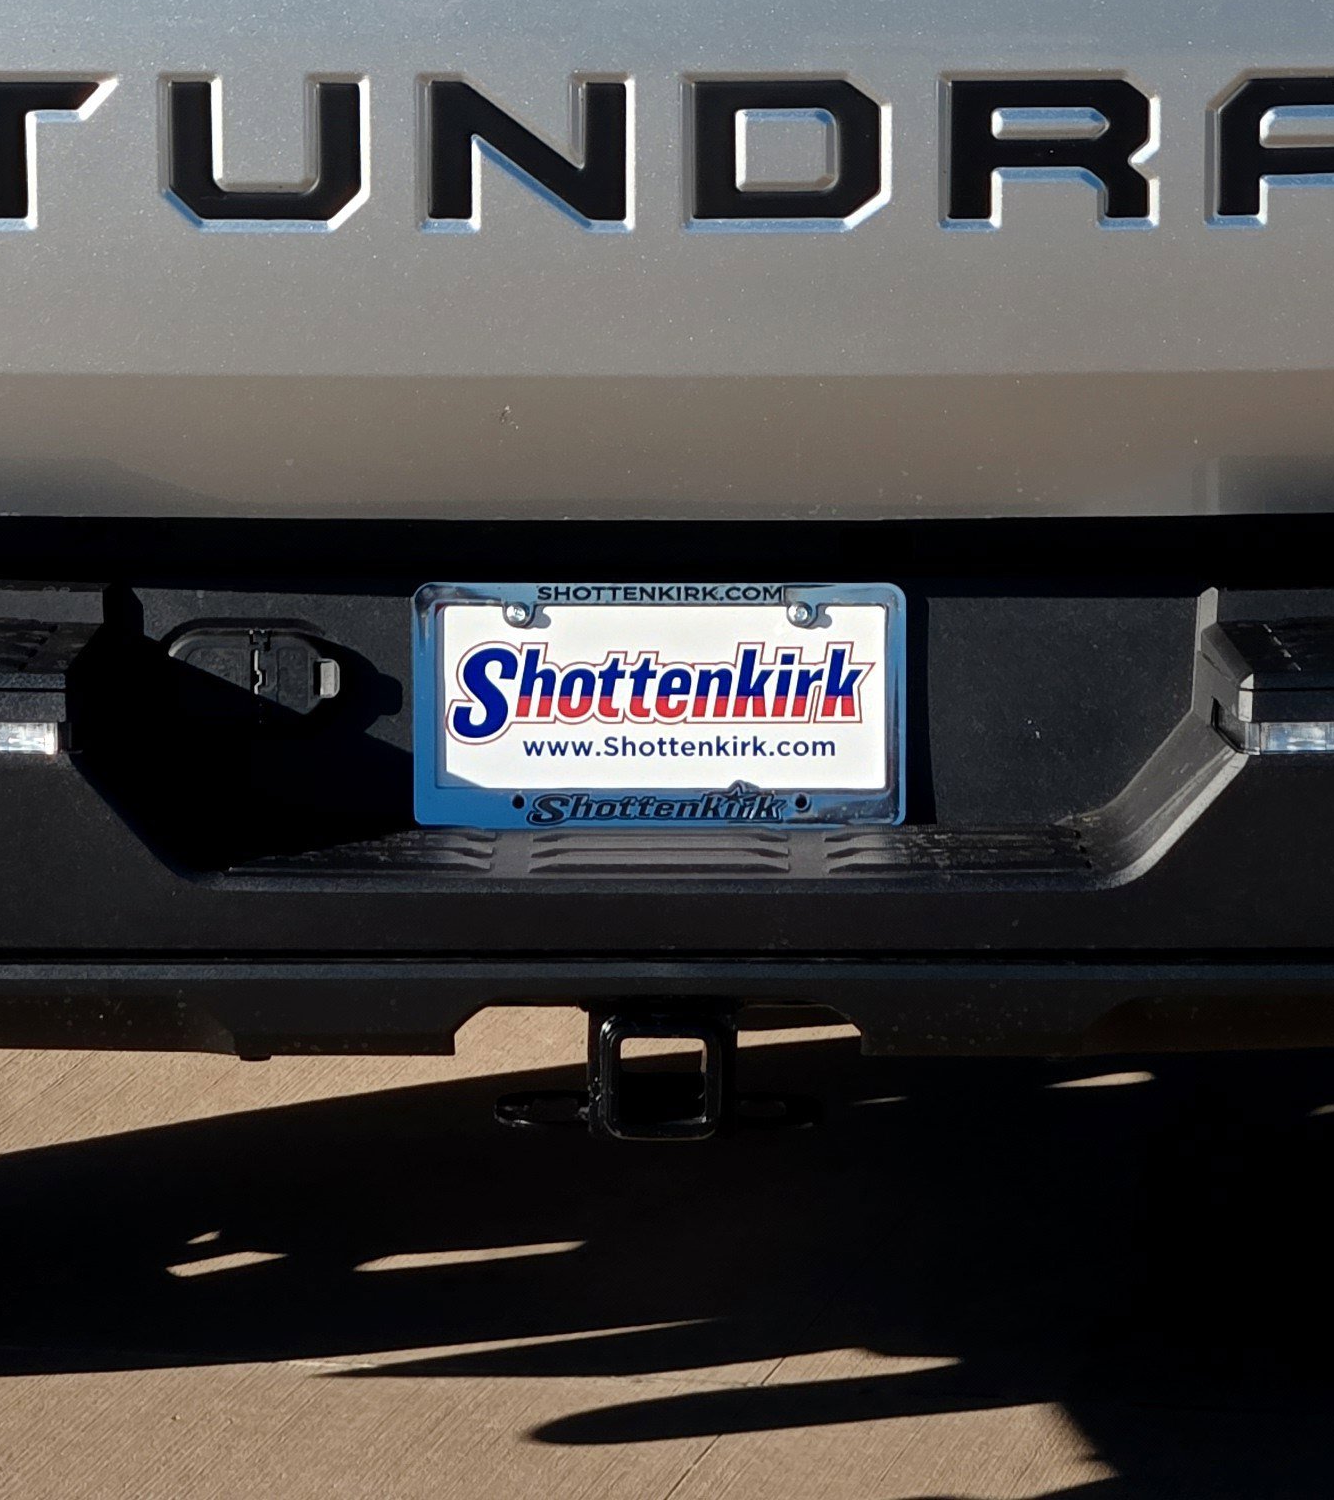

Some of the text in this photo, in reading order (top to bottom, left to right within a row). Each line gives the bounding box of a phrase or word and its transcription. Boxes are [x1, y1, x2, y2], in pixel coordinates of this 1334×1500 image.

[536, 585, 784, 602] SHOTTENKIRK.COM
[450, 644, 868, 741] Shottenkirk
[522, 735, 836, 758] www.Shottenkirk.com
[527, 792, 786, 826] Shottenkirk
